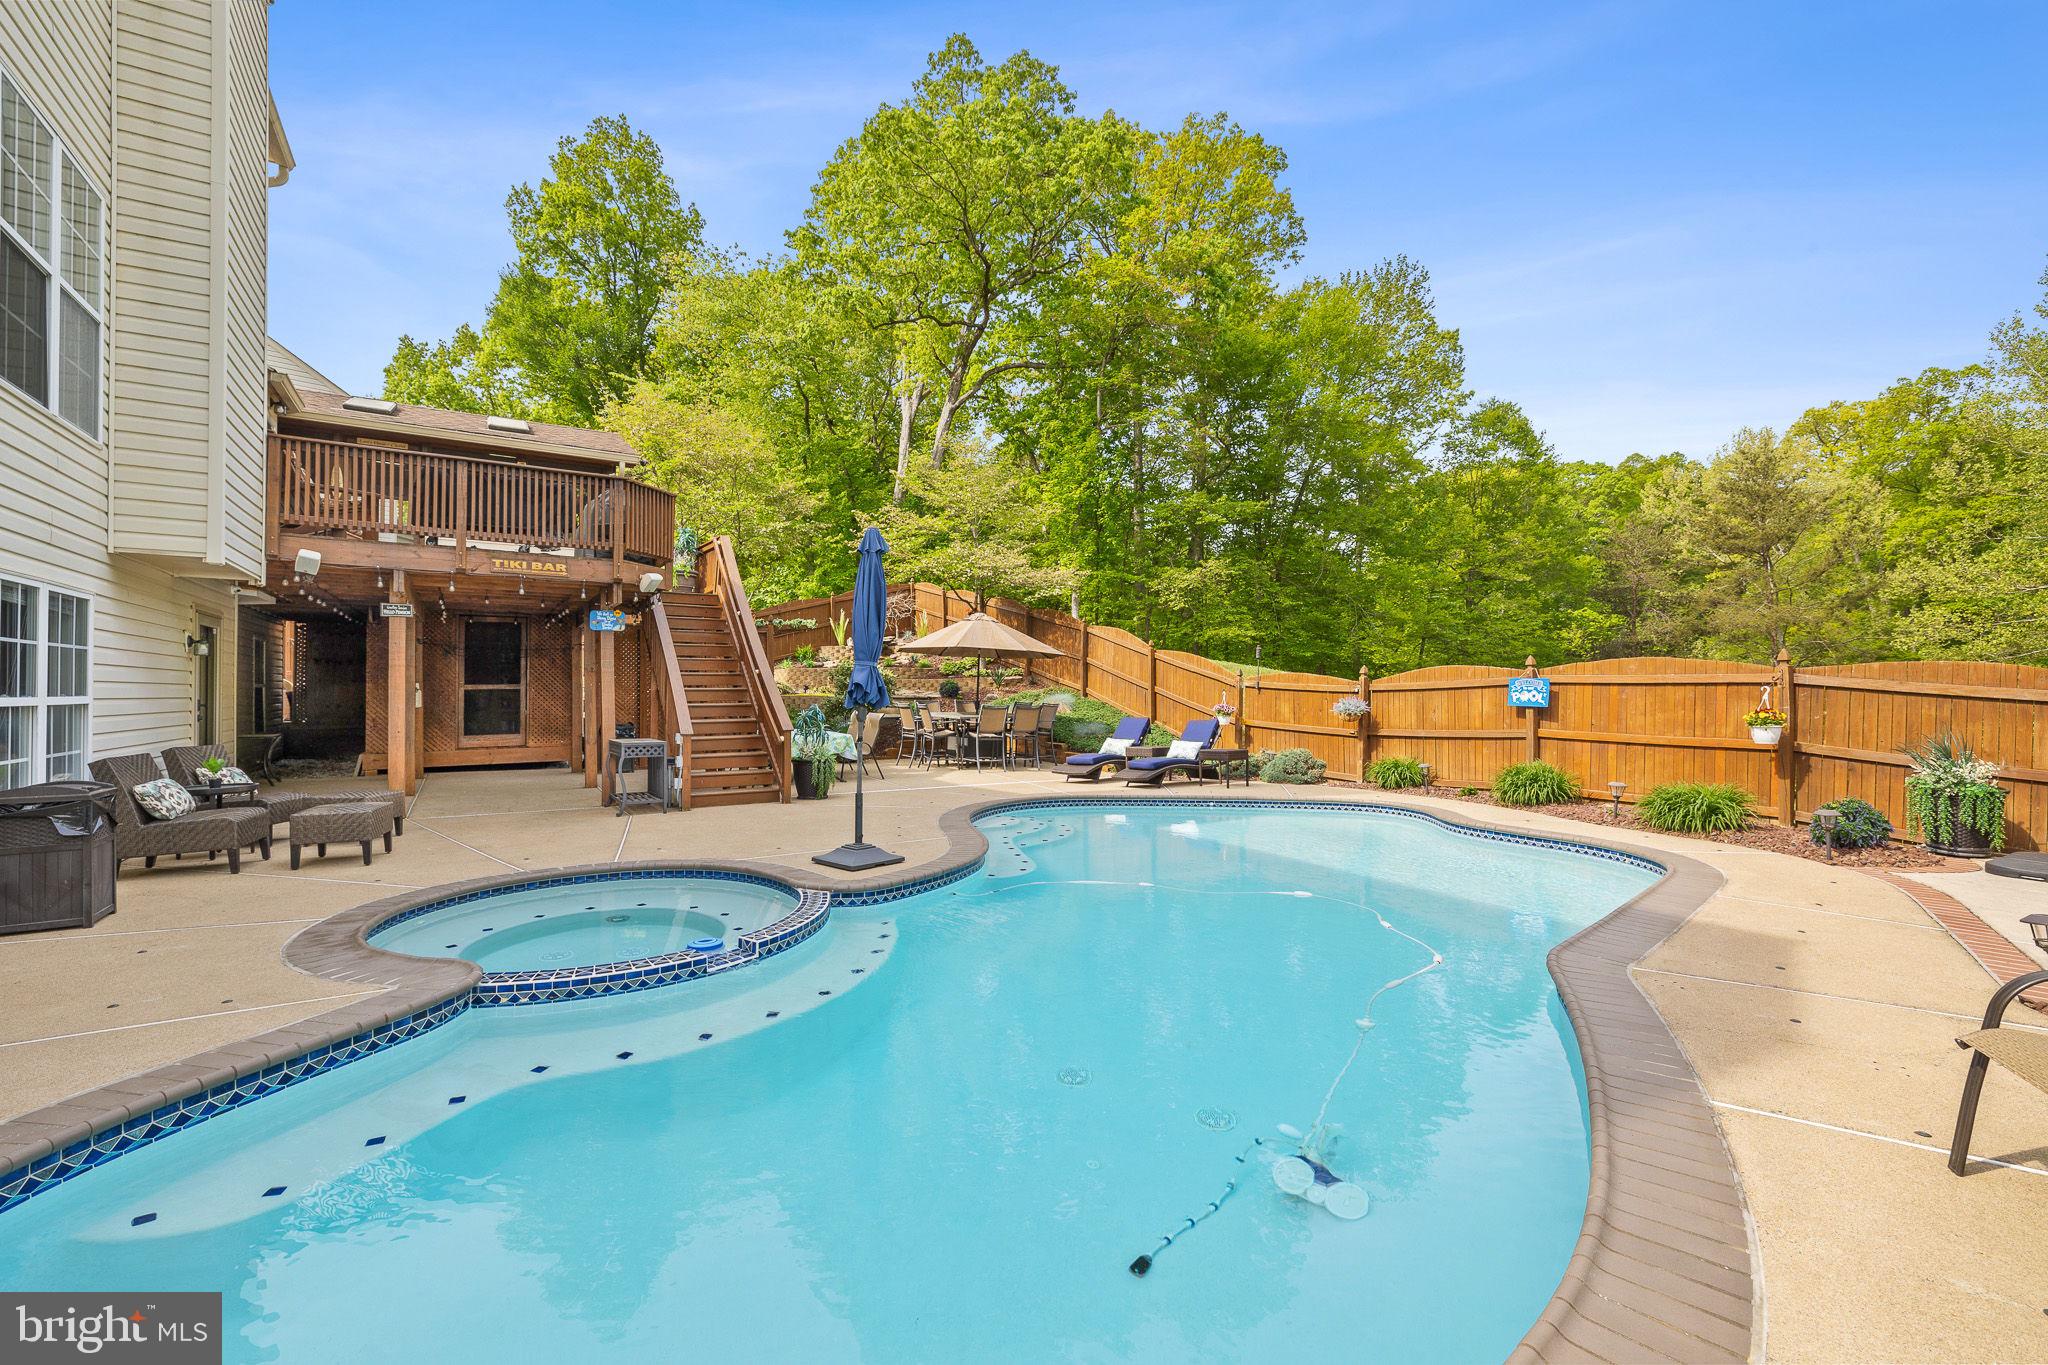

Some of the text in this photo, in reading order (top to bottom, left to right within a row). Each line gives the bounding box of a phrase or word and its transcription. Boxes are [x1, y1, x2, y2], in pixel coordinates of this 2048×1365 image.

[492, 559, 567, 572] TIKI BAR
[1511, 690, 1545, 704] POOL
